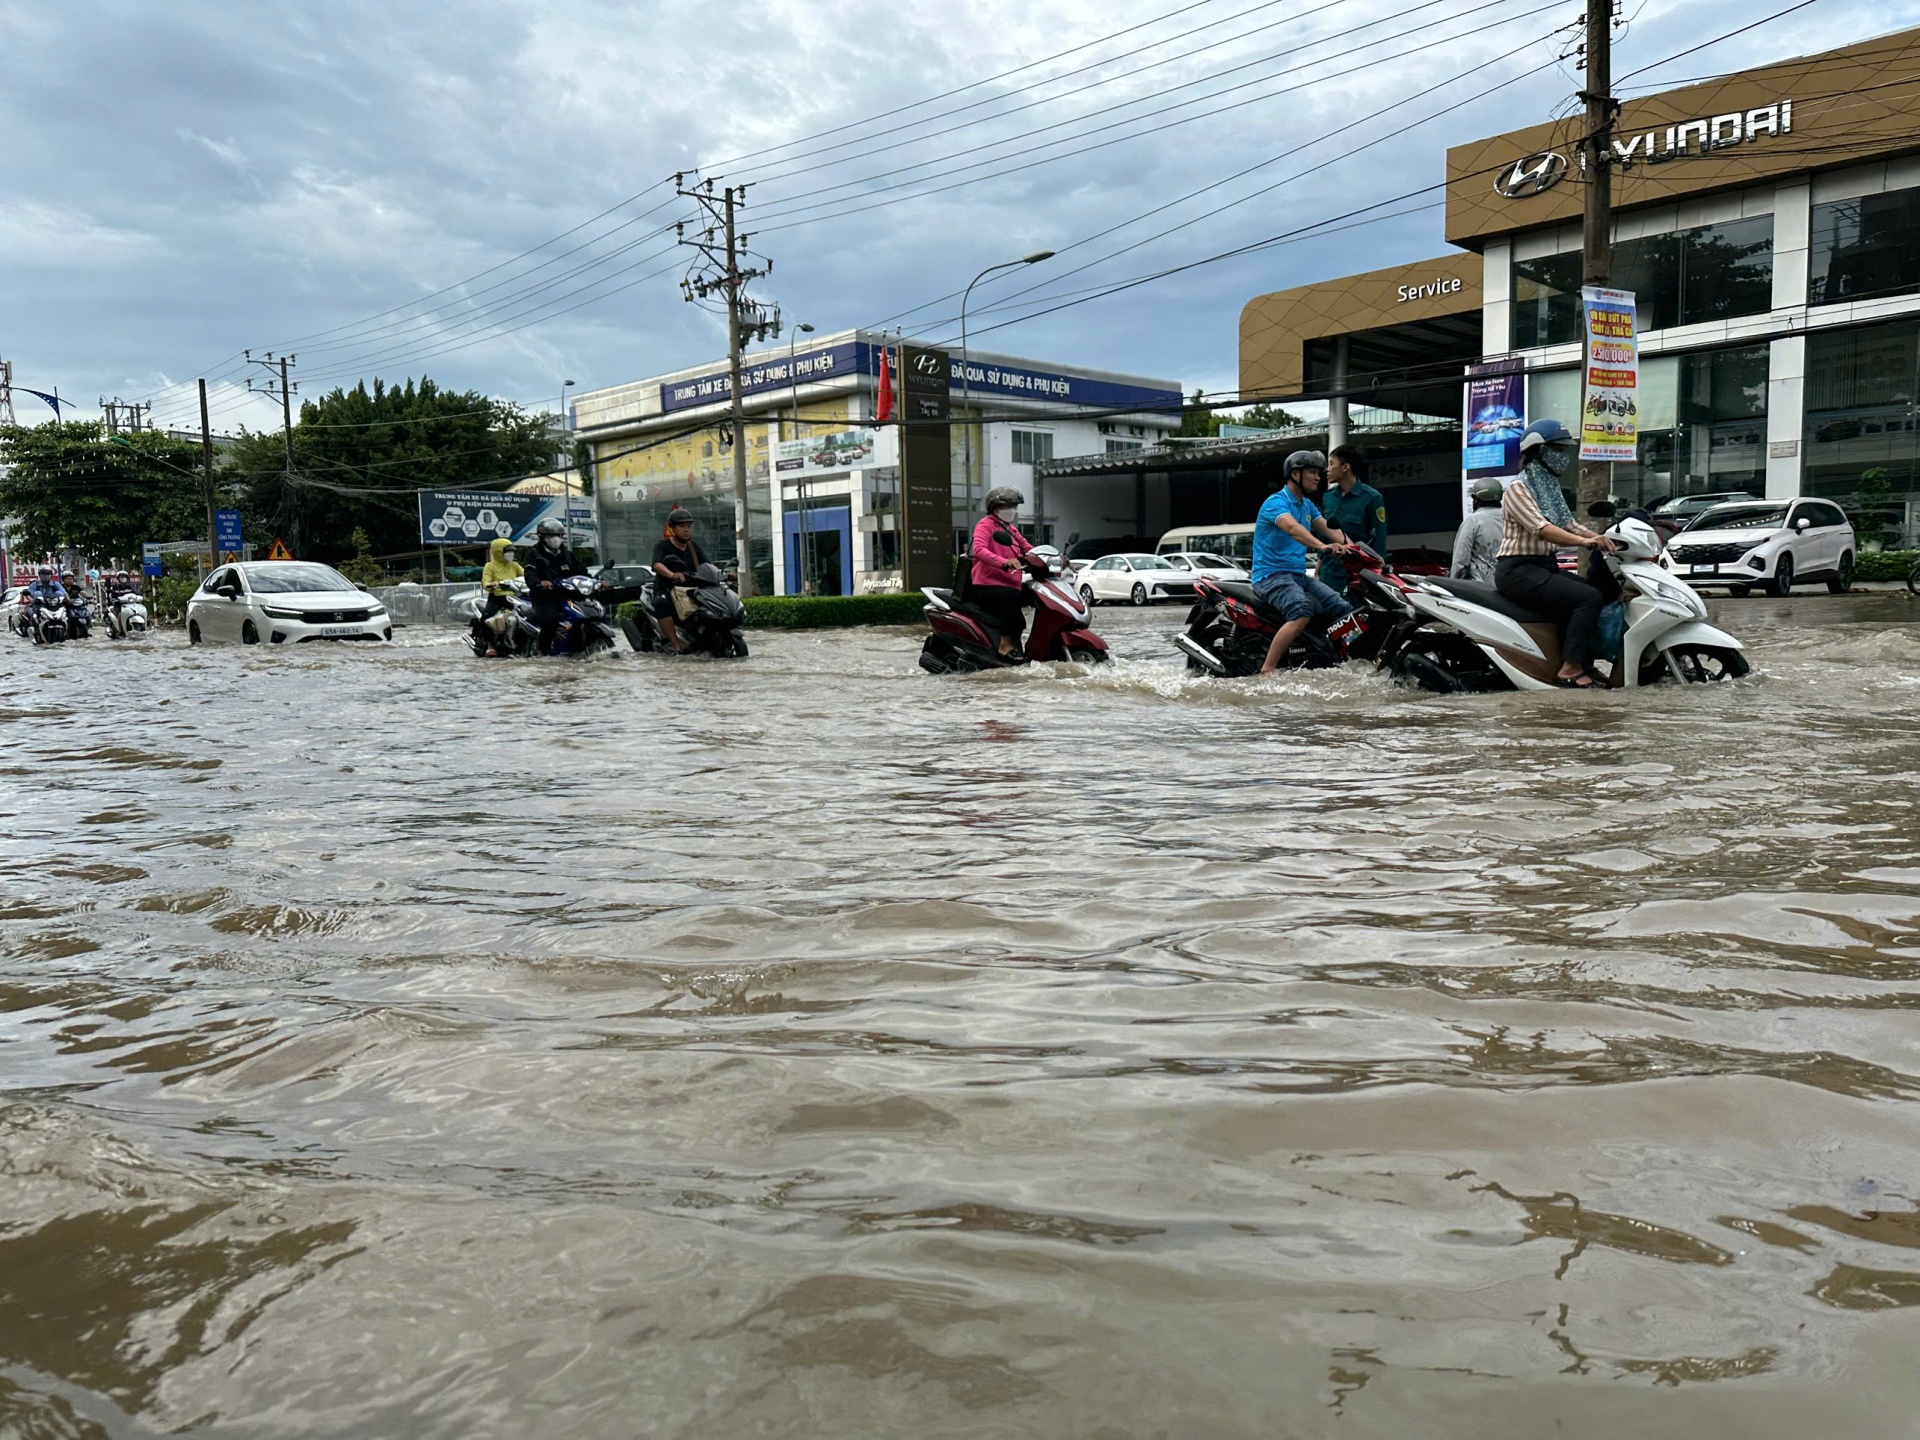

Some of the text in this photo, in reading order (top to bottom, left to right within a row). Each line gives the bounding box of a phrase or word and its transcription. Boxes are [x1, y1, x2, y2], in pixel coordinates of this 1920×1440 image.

[1581, 99, 1792, 172] YUNDAI
[1397, 277, 1461, 302] Service
[674, 386, 696, 401] TRUNG
[698, 380, 713, 396] TÂM
[713, 381, 723, 393] XE
[766, 367, 787, 384] DỤNG
[796, 360, 813, 376] PHỤ
[814, 352, 834, 373] KIỆN
[951, 363, 964, 379] ĐÃ
[966, 367, 985, 382] QUA
[987, 368, 1000, 384] SỬ
[1002, 372, 1024, 390] DỤNG
[1026, 378, 1033, 389] &
[1034, 379, 1050, 394] PHỤ
[1052, 378, 1070, 397] KIỆN
[1288, 647, 1306, 655] YAMAHA
